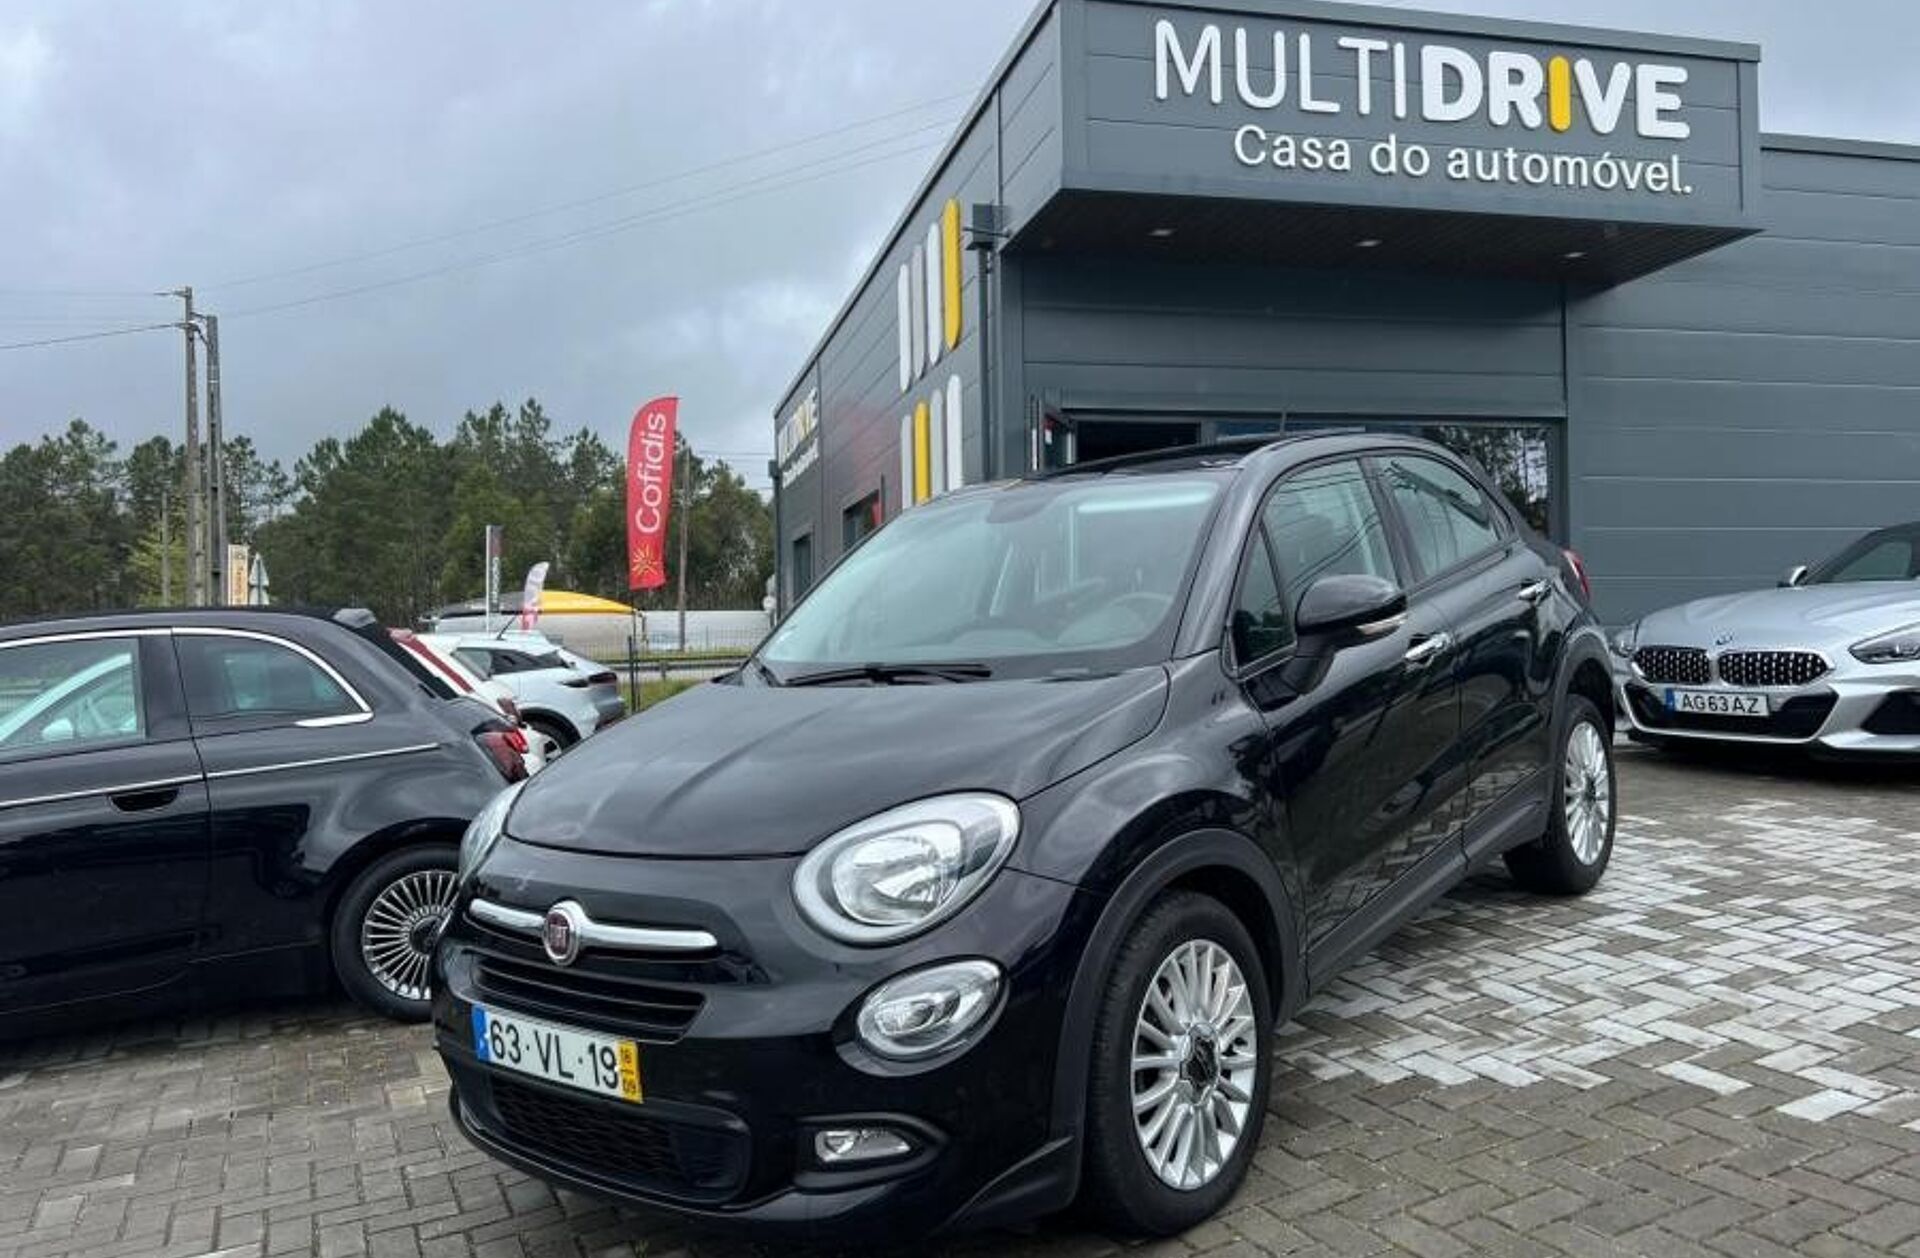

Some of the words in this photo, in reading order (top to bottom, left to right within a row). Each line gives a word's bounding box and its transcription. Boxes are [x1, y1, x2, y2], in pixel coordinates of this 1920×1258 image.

[1153, 18, 1691, 139] MULTIDRIVE
[1233, 124, 1352, 172] Casa
[1369, 133, 1430, 176] do
[1447, 143, 1692, 195] automóvel.
[635, 412, 666, 534] Cofidis
